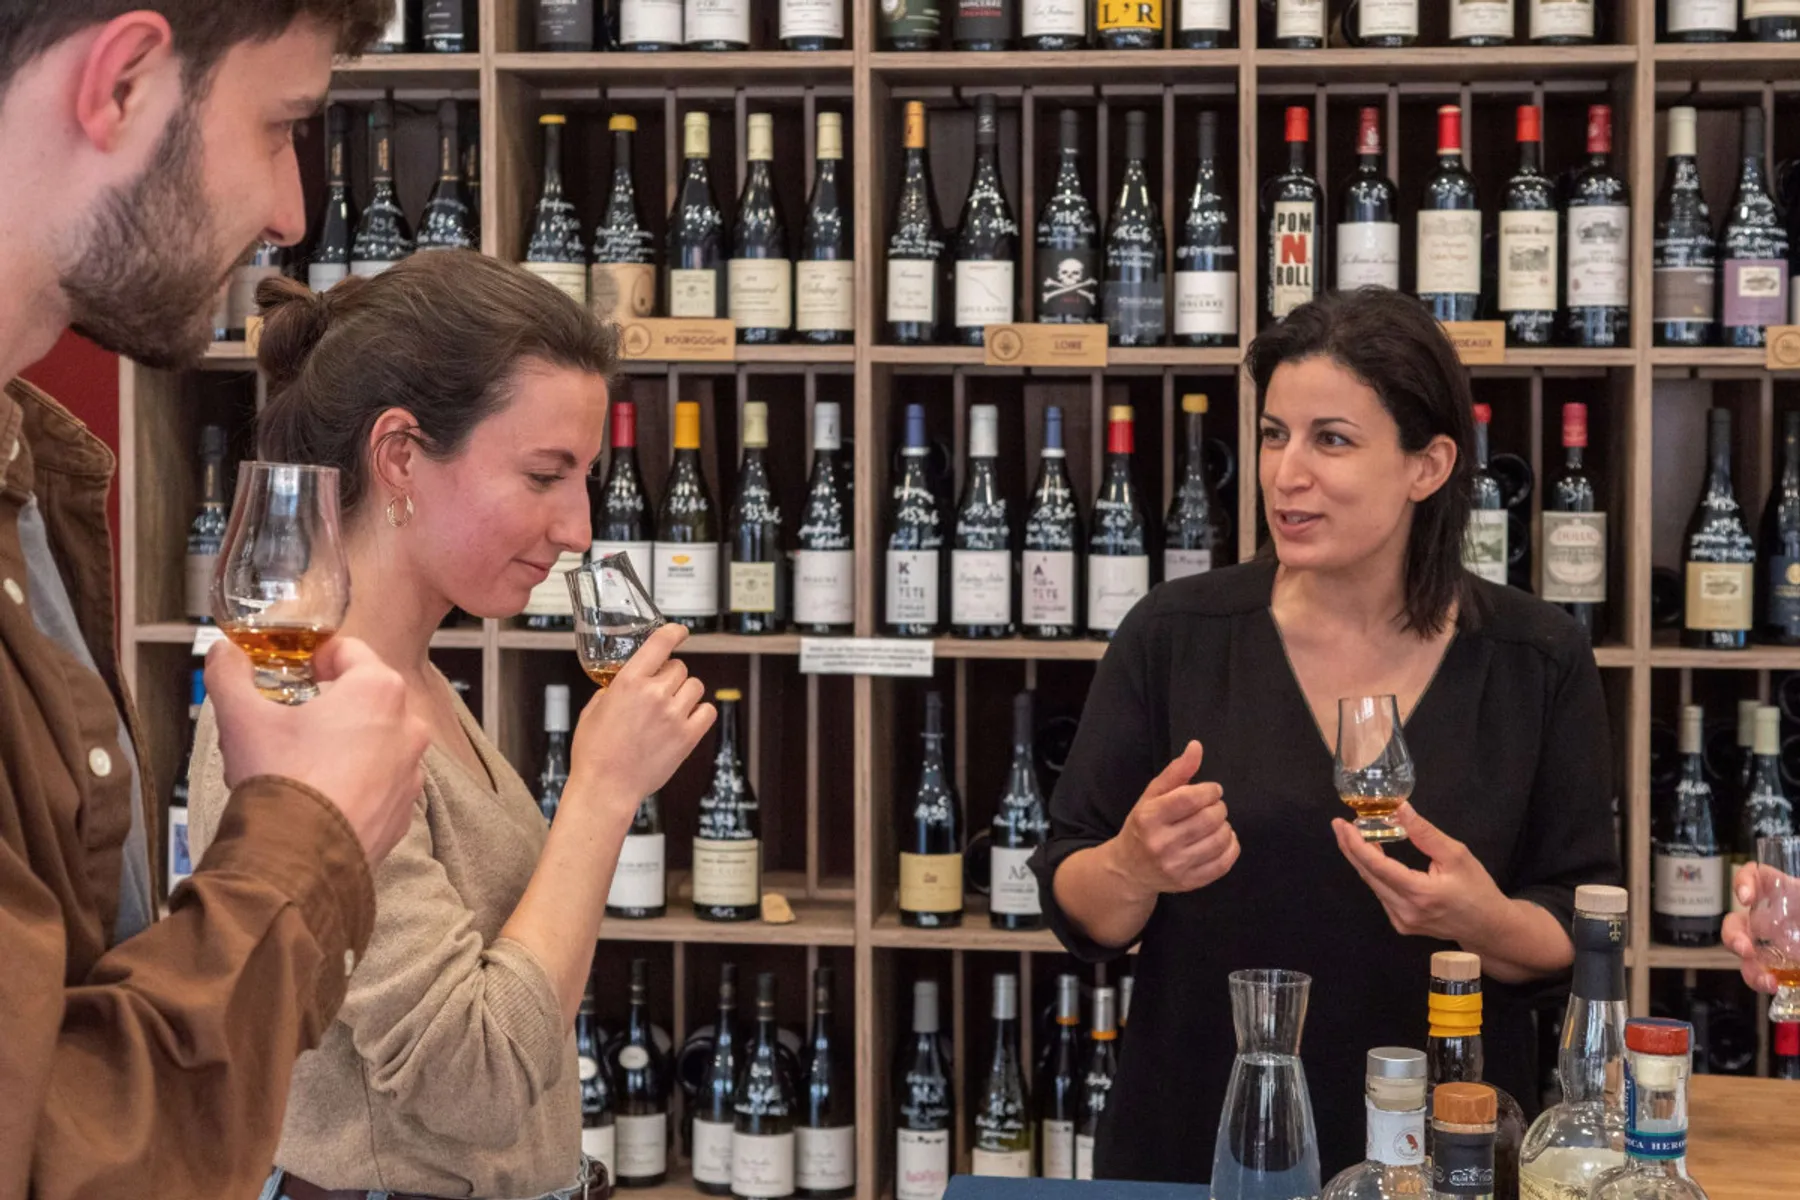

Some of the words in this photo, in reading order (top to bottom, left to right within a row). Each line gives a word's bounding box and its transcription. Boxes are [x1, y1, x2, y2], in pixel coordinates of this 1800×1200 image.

[1277, 212, 1312, 233] POM
[1276, 265, 1311, 286] ROLL
[664, 336, 728, 345] BOURGOGNE
[1054, 340, 1082, 350] LOIRE
[898, 561, 910, 574] K
[1033, 564, 1044, 576] A
